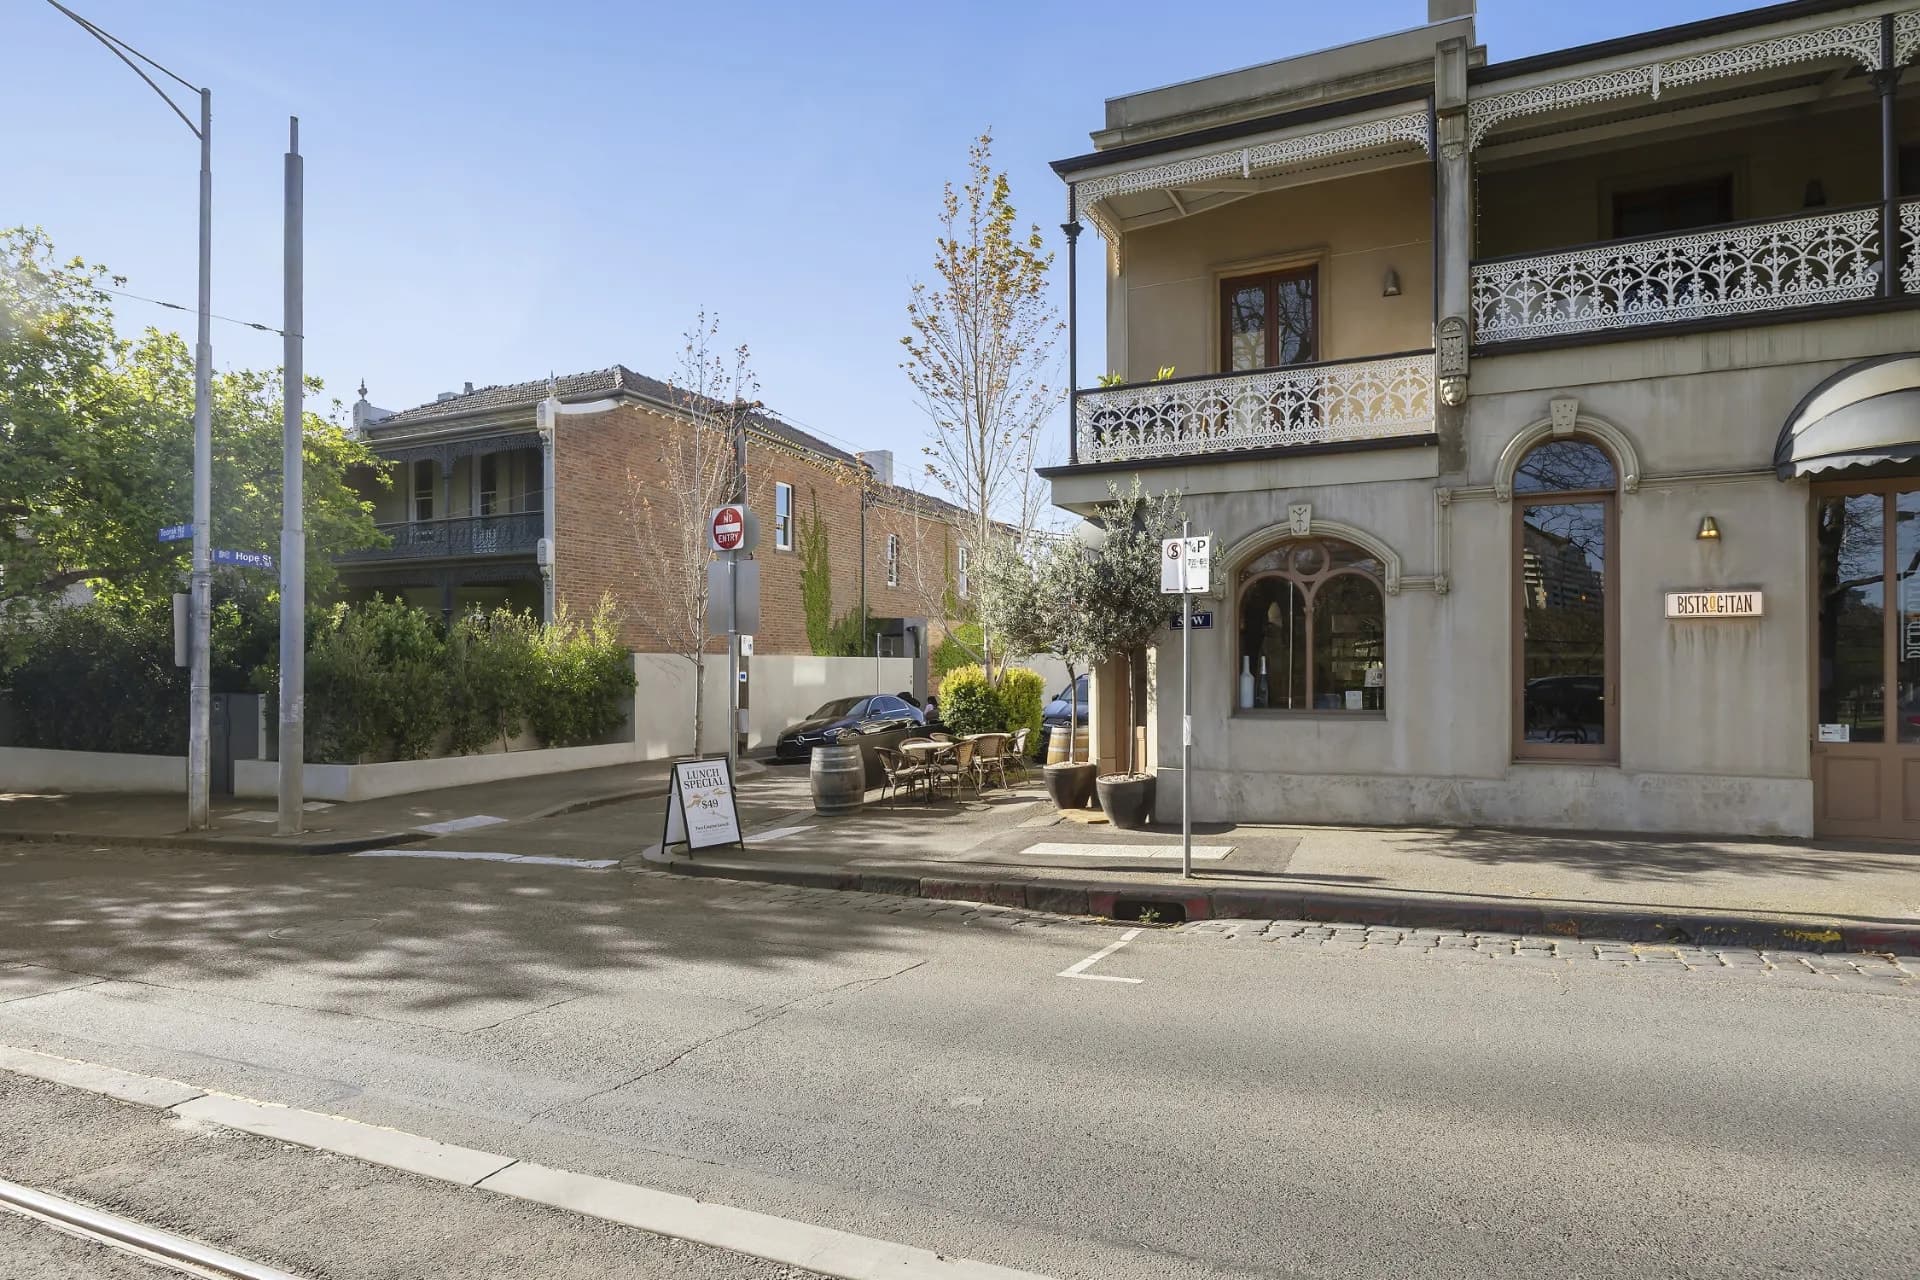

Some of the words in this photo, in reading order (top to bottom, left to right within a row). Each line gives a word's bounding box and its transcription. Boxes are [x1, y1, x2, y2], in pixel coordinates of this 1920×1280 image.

[723, 514, 733, 523] NO
[718, 533, 739, 543] ENTRY
[235, 551, 260, 563] Hope
[262, 554, 272, 563] St
[686, 768, 720, 780] LUNCH
[683, 777, 726, 790] SPECIAL
[701, 799, 719, 809] $49
